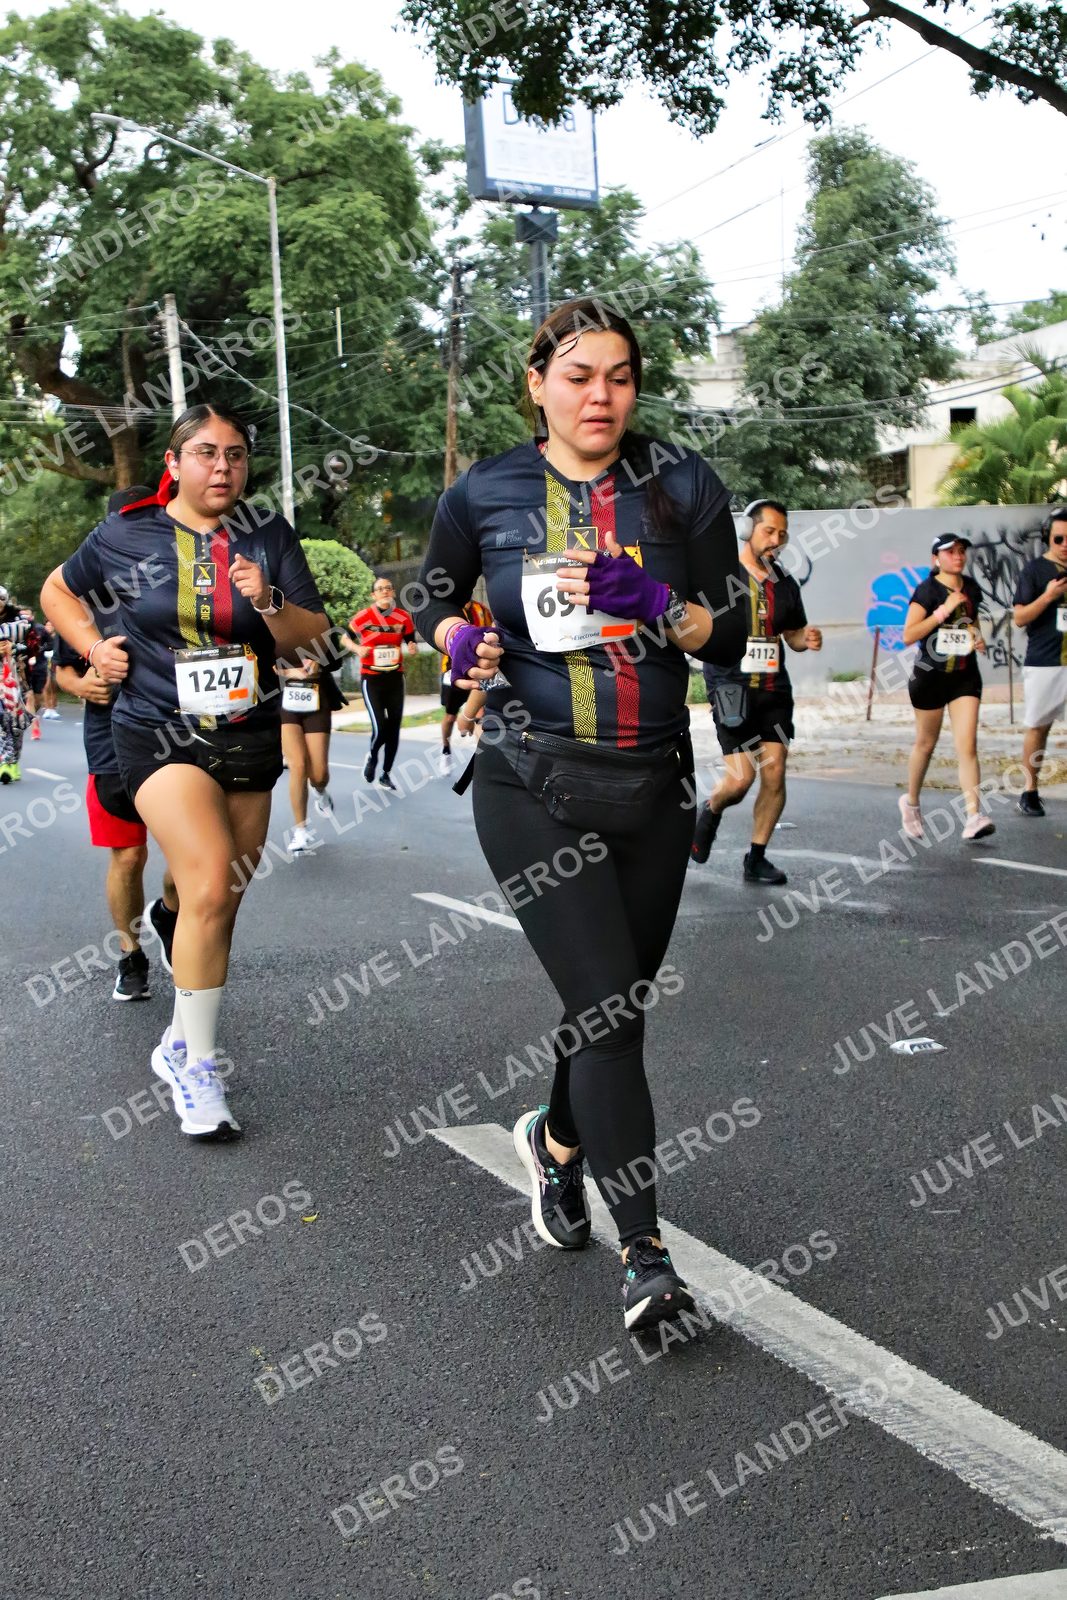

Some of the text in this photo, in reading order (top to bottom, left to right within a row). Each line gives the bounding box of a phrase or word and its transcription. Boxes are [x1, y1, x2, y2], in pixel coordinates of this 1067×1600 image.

[748, 648, 775, 660] 4112
[188, 665, 244, 693] 1247
[288, 691, 312, 701] 5866
